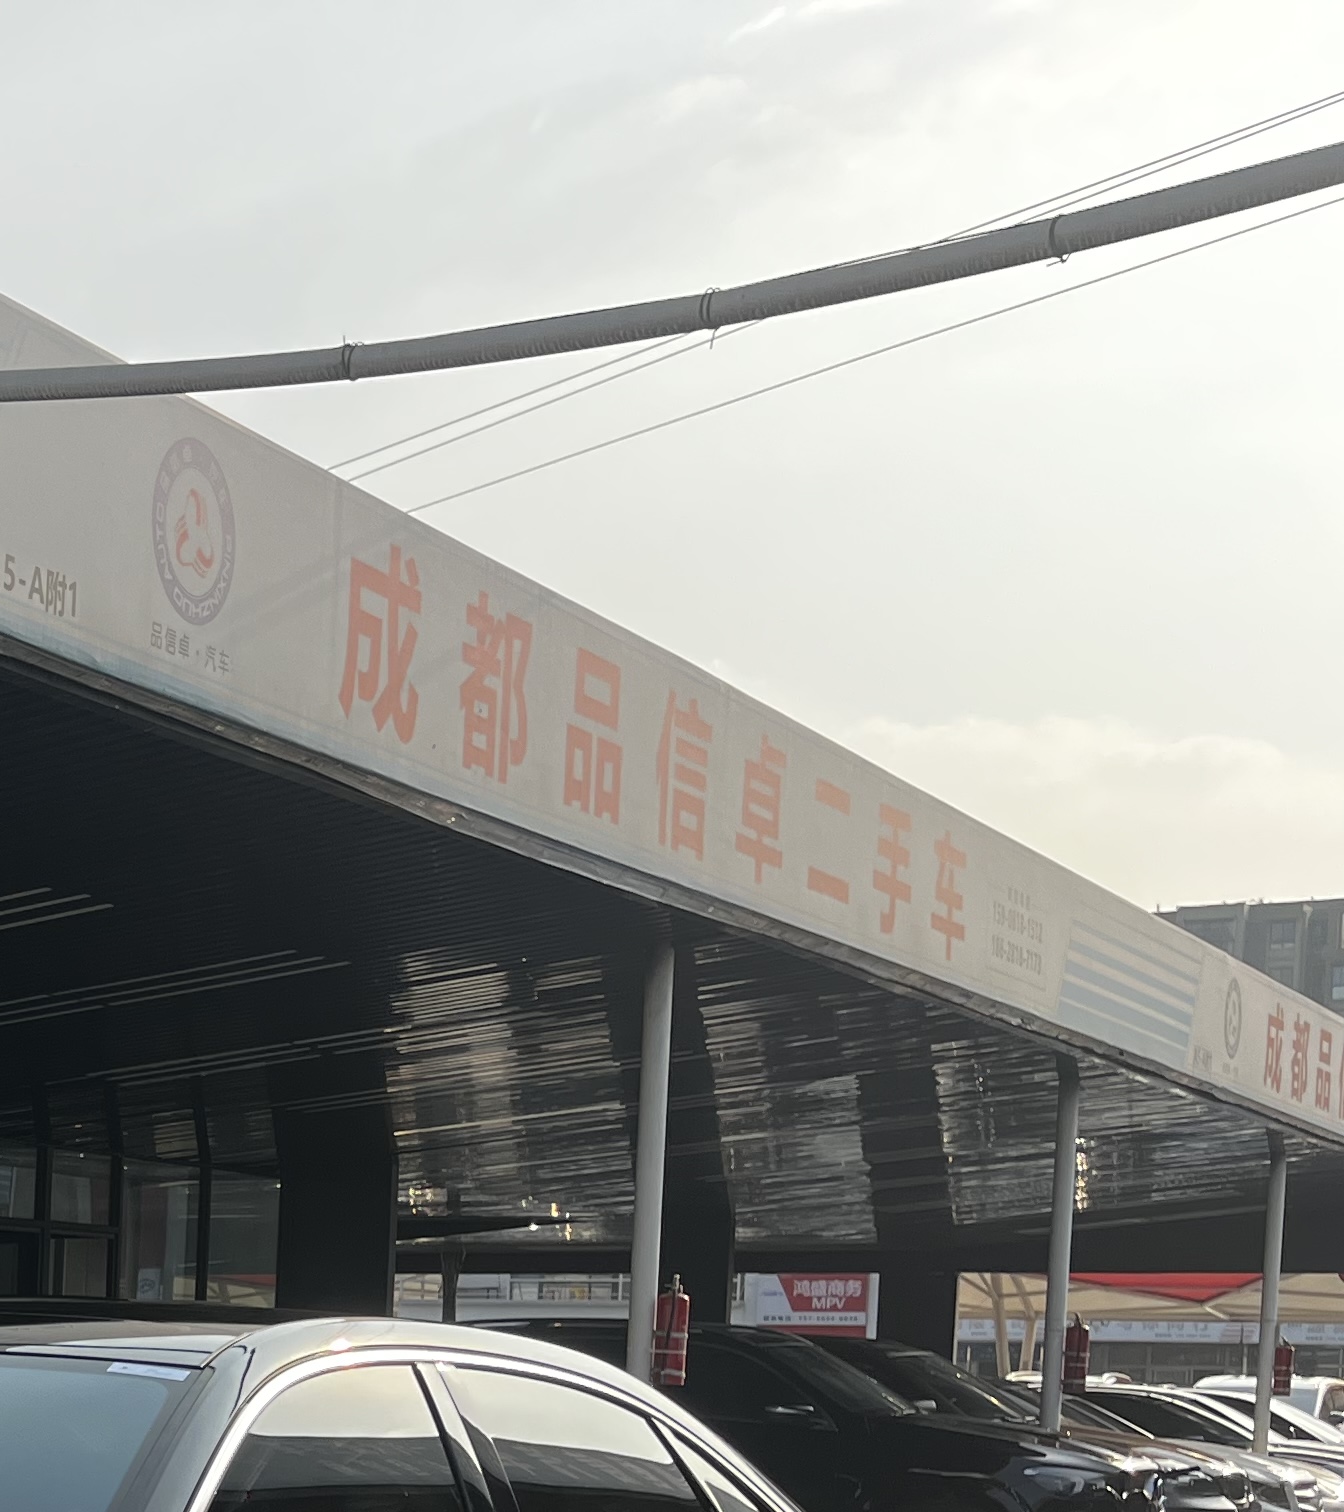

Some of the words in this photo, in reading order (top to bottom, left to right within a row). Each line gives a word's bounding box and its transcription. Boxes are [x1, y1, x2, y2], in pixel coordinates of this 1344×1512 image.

[338, 542, 967, 962] 成都品信卓二手车
[1264, 1002, 1344, 1122] 成都品
[811, 1297, 847, 1310] MPV
